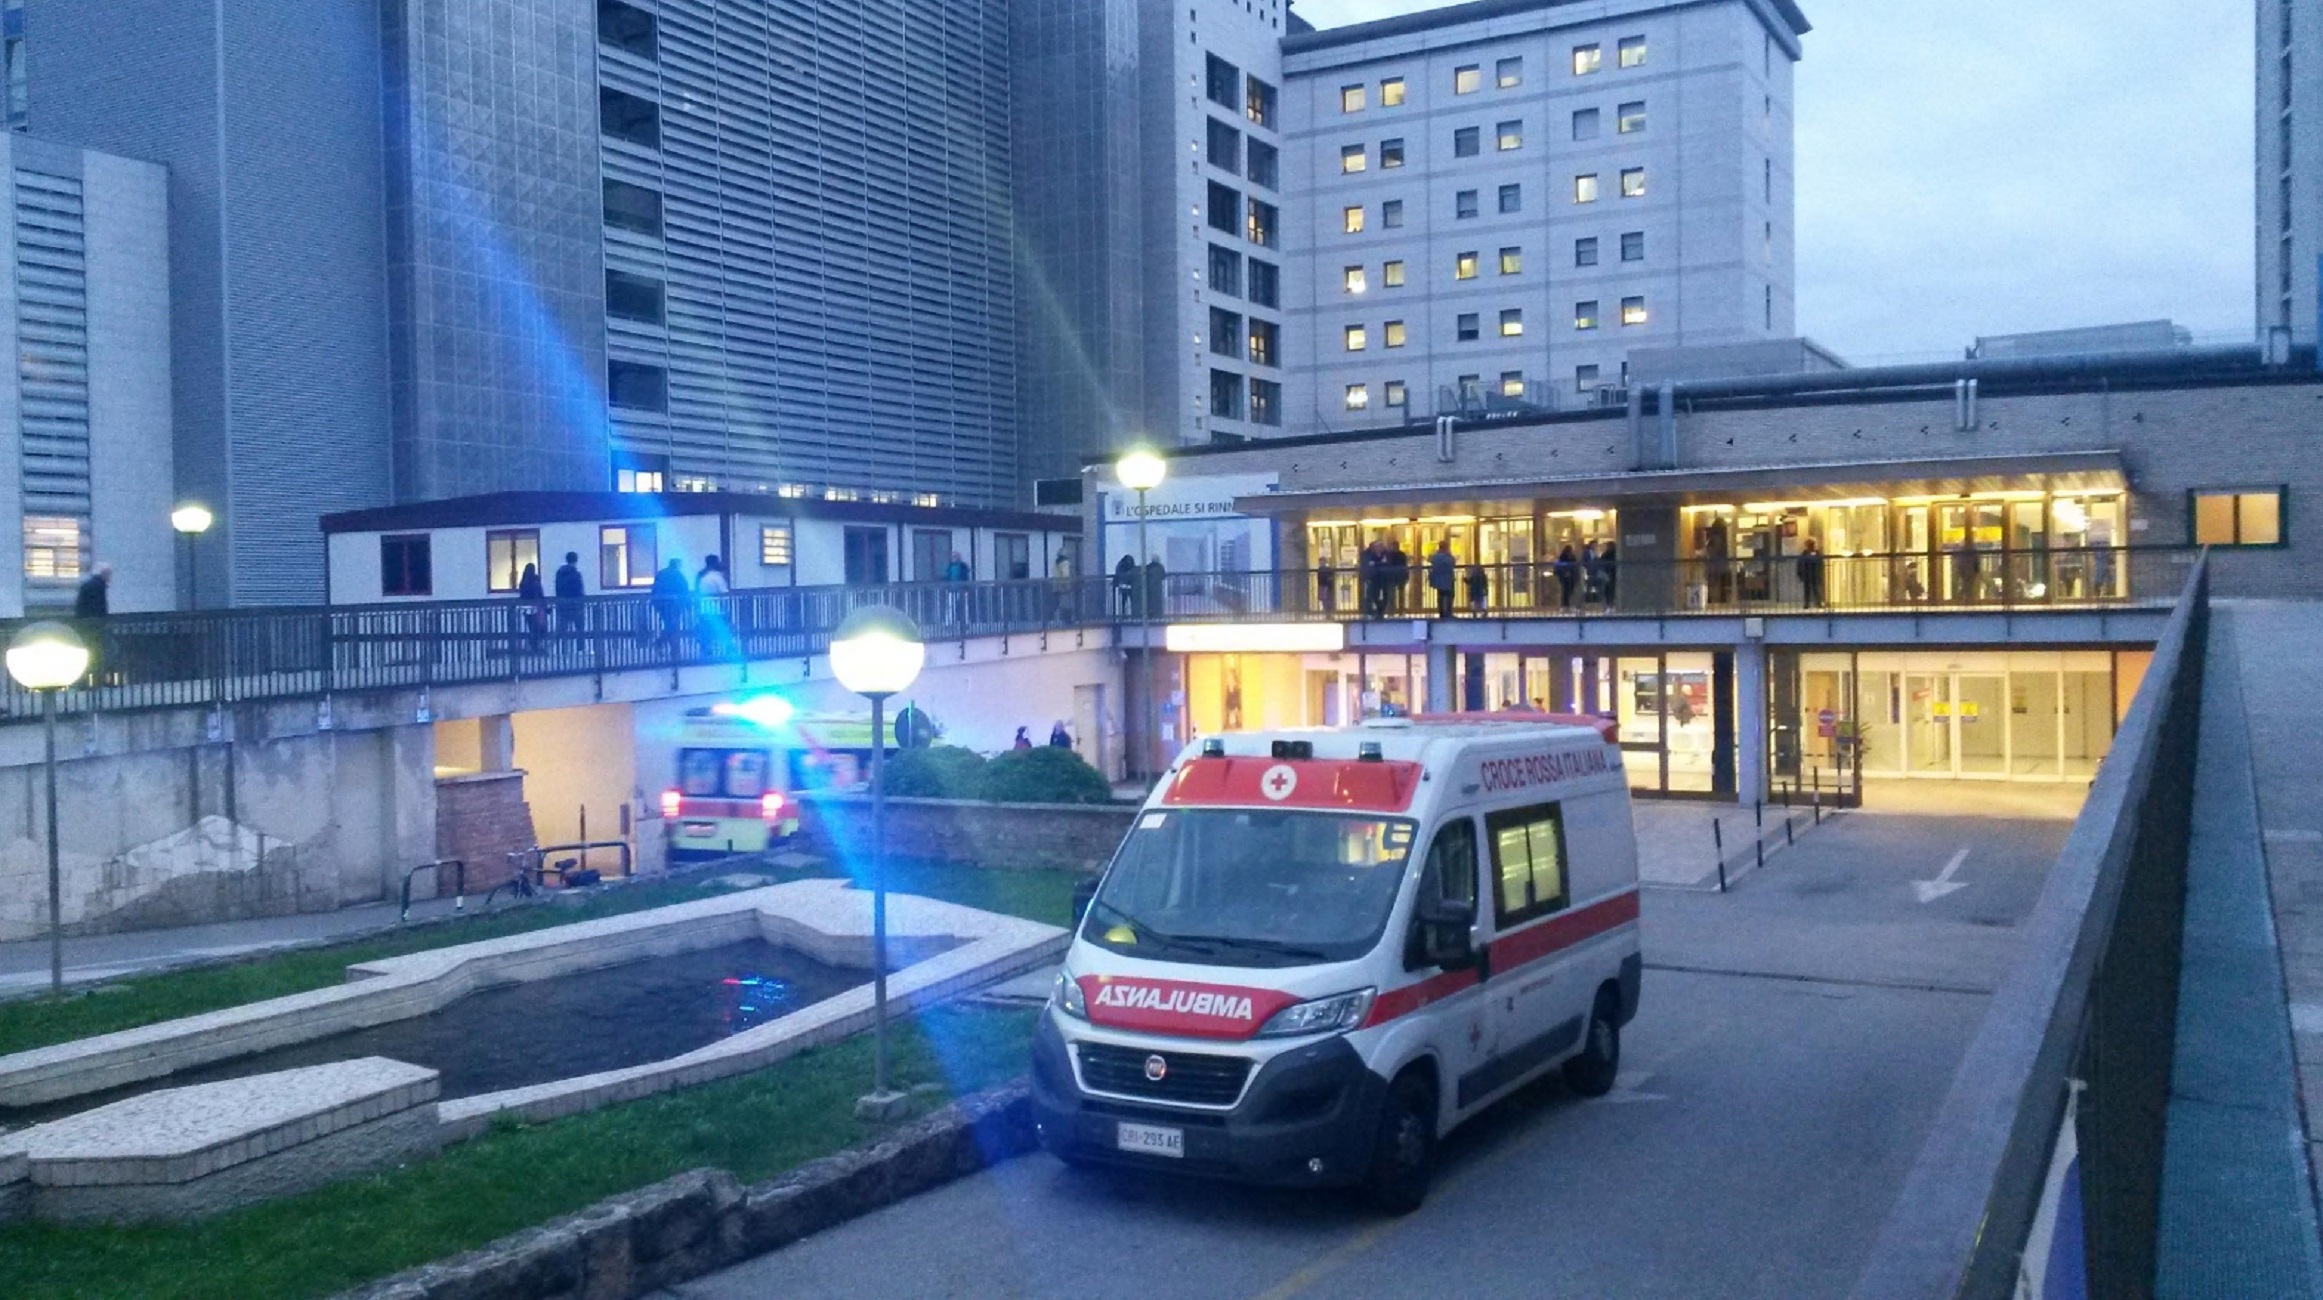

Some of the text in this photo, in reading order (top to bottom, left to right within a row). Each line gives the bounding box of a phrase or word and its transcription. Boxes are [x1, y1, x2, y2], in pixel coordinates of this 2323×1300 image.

[1194, 502, 1205, 514] SI
[1481, 757, 1527, 792] CROCE
[1525, 752, 1565, 785] ROSSA
